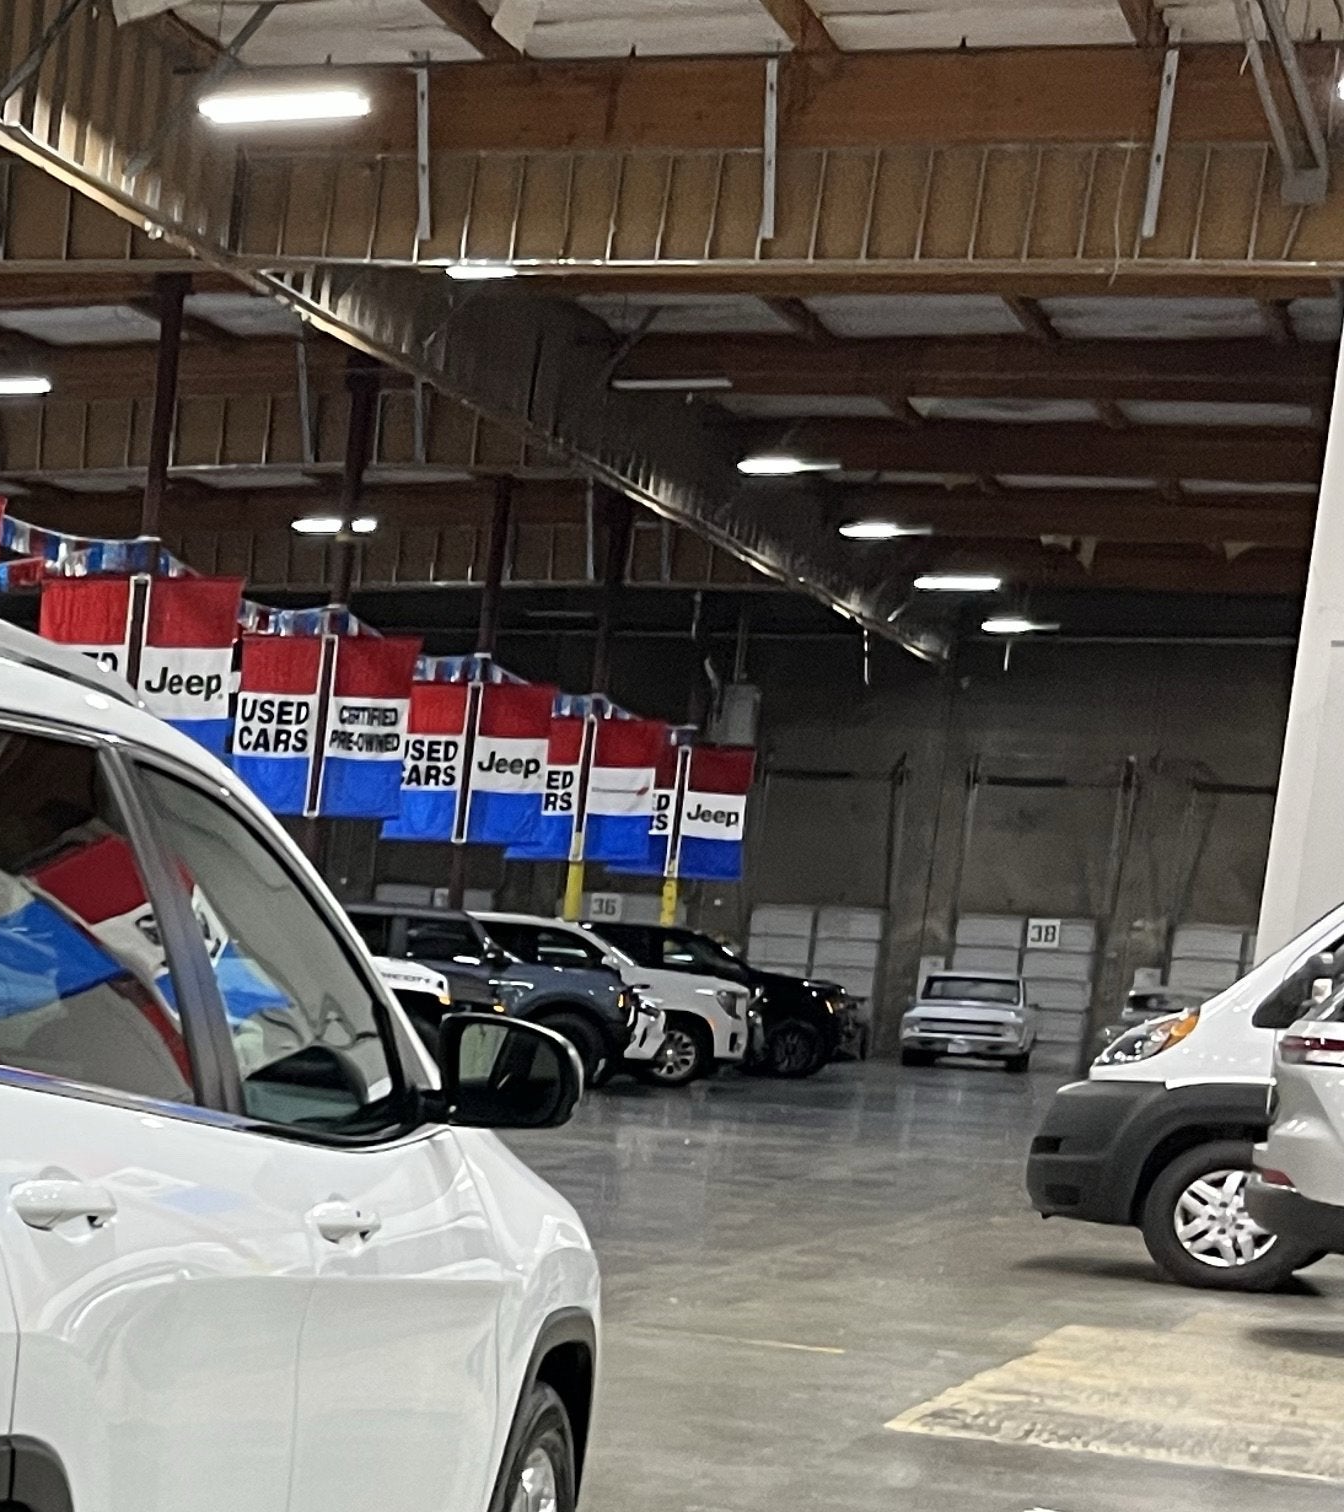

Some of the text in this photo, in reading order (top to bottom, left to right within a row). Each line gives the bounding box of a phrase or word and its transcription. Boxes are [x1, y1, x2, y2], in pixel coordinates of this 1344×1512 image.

[144, 666, 222, 701] Jeep
[241, 698, 310, 725] USED
[238, 726, 308, 753] CARS
[406, 764, 456, 786] ARS
[477, 751, 541, 779] Jeep
[687, 804, 740, 828] Jeep
[593, 898, 616, 915] 36
[1030, 925, 1057, 942] 38
